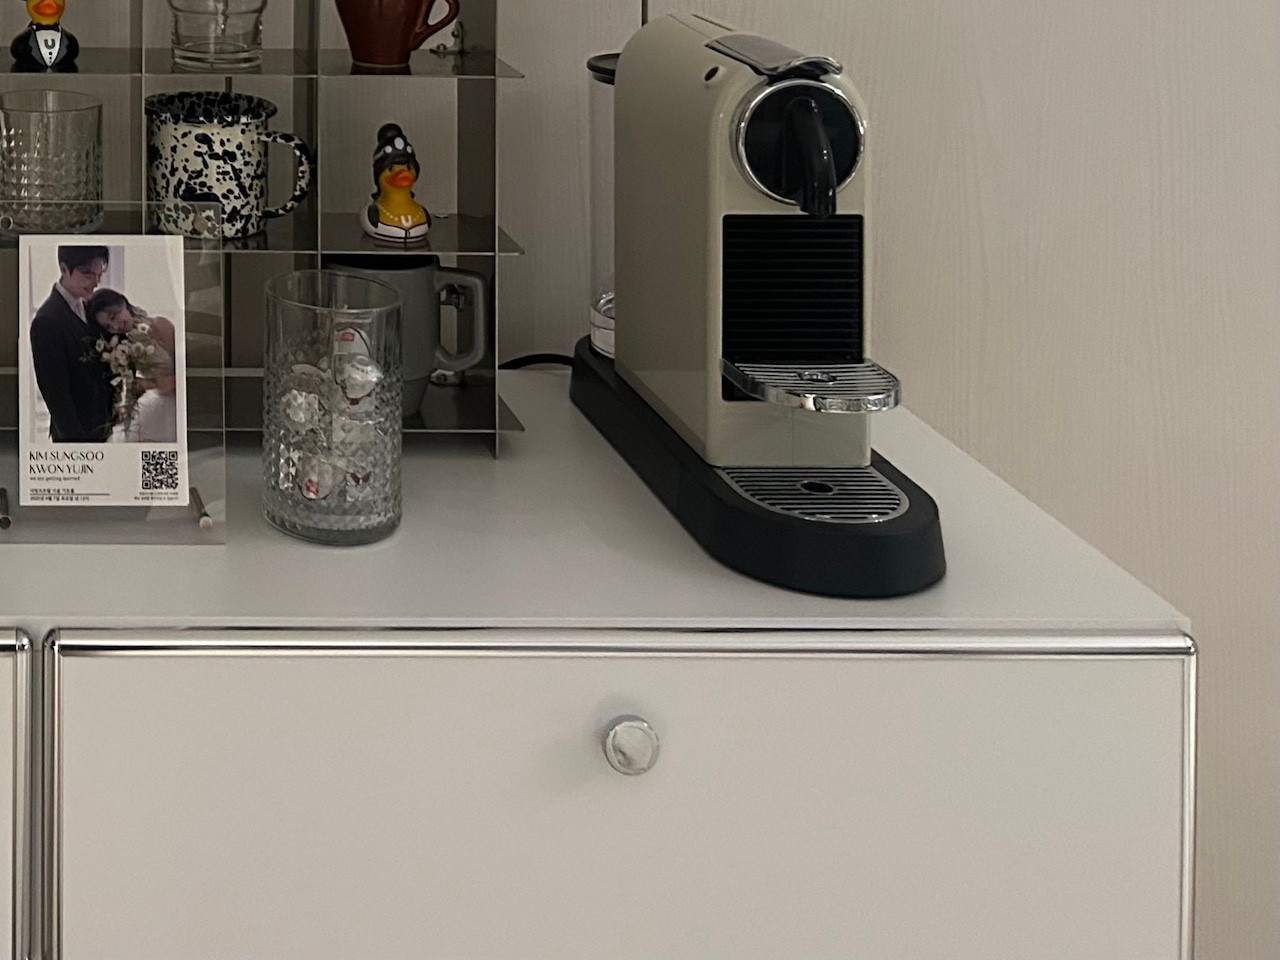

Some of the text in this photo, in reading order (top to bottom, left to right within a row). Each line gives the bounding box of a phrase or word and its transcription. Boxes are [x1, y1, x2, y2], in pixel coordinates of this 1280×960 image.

[29, 450, 105, 461] KIM SUNGSOO
[29, 463, 94, 474] KWON YUJIN
